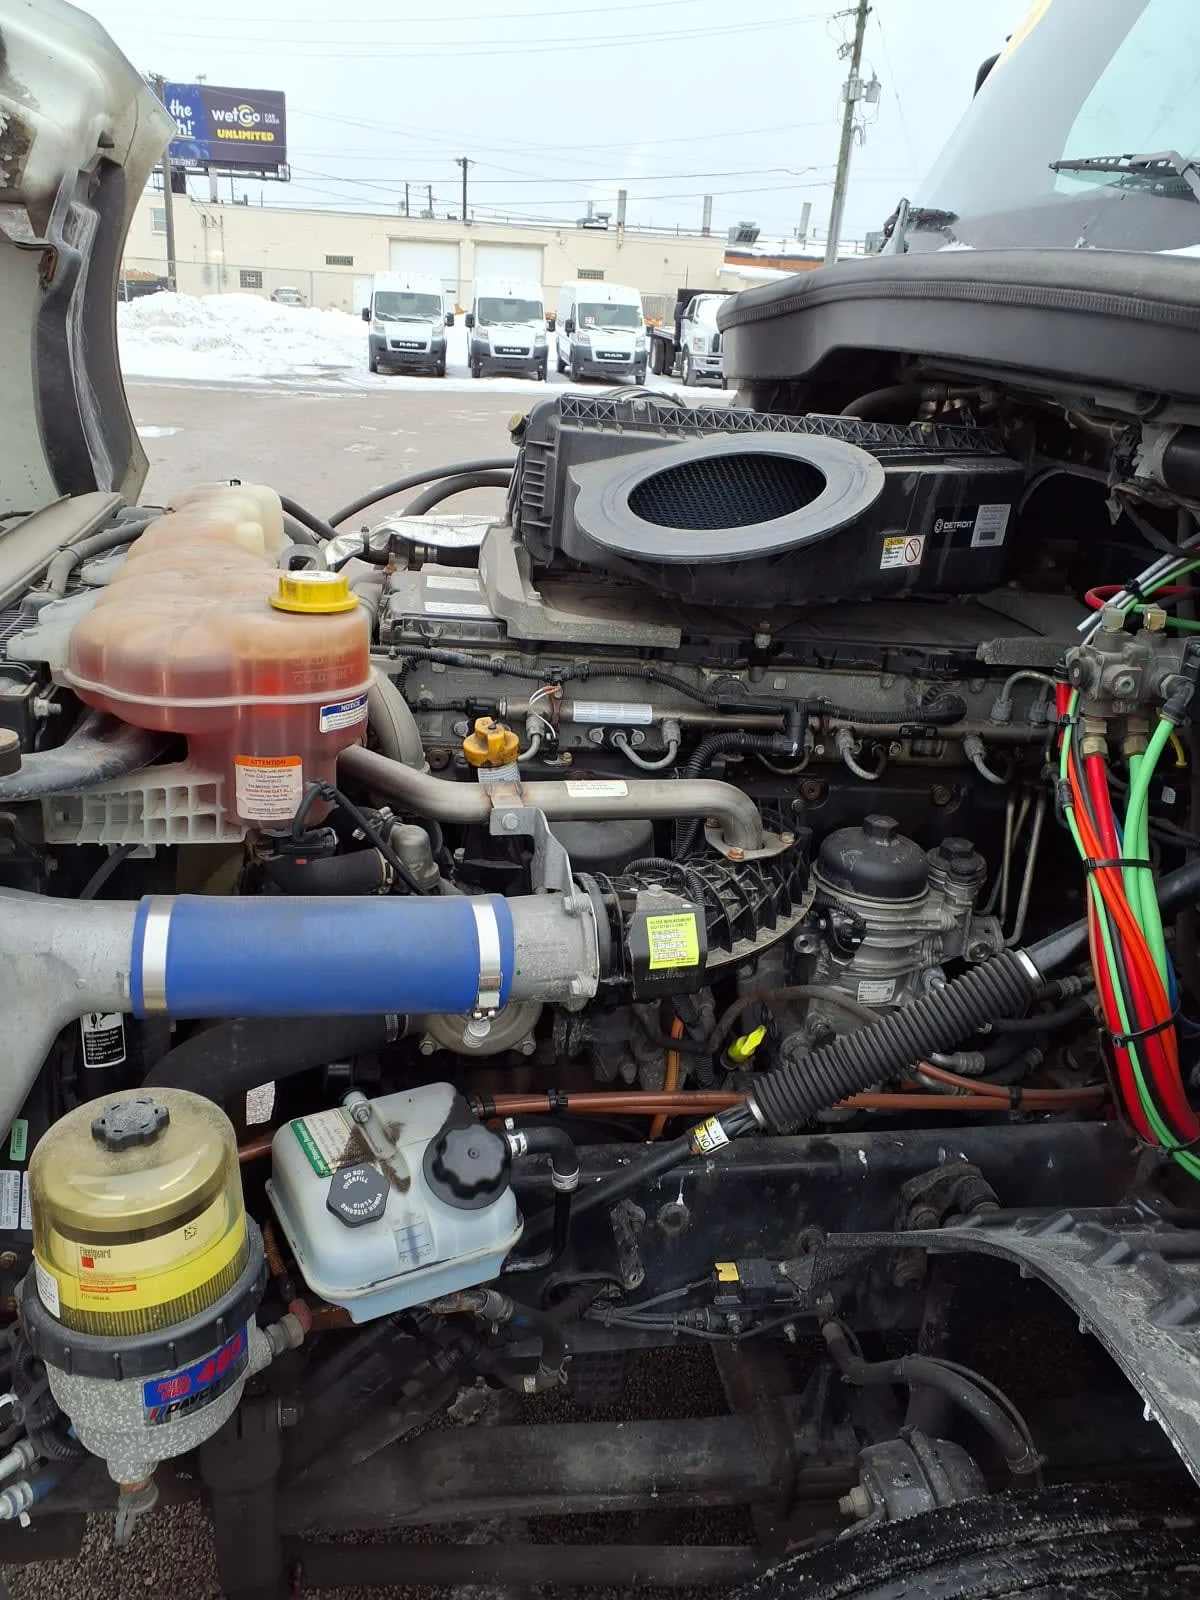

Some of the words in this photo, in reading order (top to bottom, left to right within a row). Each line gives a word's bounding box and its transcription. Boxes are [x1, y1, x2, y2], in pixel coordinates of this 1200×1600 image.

[169, 98, 193, 118] the
[216, 128, 275, 142] UNLIMITED
[943, 520, 974, 529] DETROIT
[340, 700, 361, 711] NOTICE
[342, 1175, 369, 1190] OVERFILL
[343, 1172, 352, 1180] DO
[352, 1198, 373, 1209] FLUID
[367, 1193, 383, 1211] POWER
[340, 1203, 368, 1215] STEERING
[79, 1246, 112, 1260] Fleetguard
